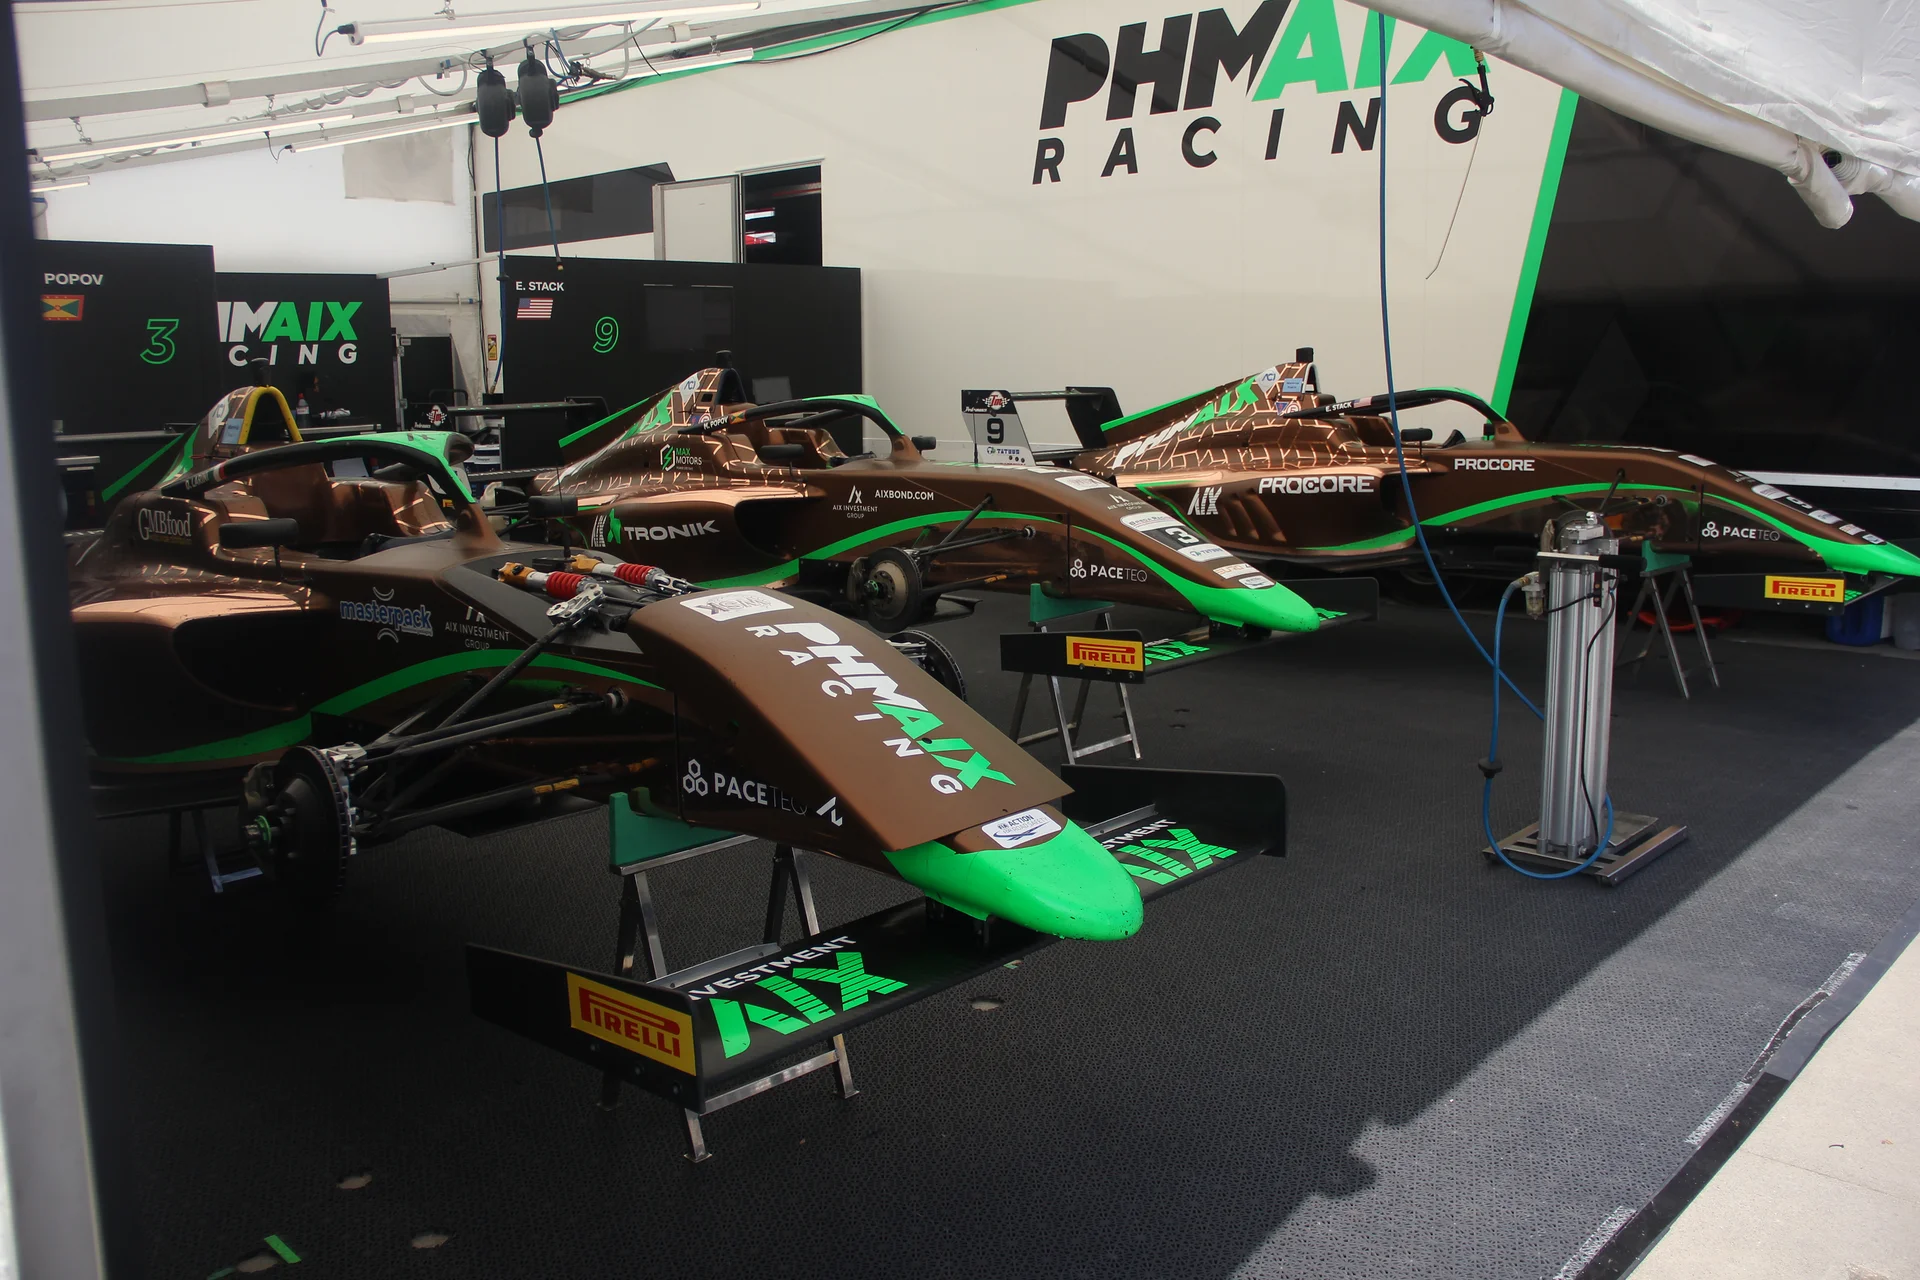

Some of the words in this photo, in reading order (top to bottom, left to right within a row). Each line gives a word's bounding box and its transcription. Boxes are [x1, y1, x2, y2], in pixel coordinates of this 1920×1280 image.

[1032, 86, 1483, 185] RACING
[44, 273, 104, 286] POPOV
[515, 281, 526, 291] E.
[528, 281, 565, 292] STACK
[140, 318, 180, 365] 3
[592, 316, 619, 354] 9
[1325, 405, 1332, 413] E.
[1332, 401, 1353, 411] STACK
[711, 415, 729, 429] POPOV
[986, 417, 1005, 445] 9
[675, 447, 691, 456] MAX
[675, 456, 703, 466] MOTORS
[1453, 458, 1536, 472] PROCORE
[1258, 475, 1375, 495] PROCORE
[874, 489, 935, 502] AIXBOND.COM
[843, 504, 878, 513] INVESTMENT
[138, 507, 192, 541] GMBfood
[624, 519, 721, 541] TRONIK
[1722, 525, 1781, 542] PACETEQ
[1164, 527, 1200, 545] 3
[1090, 564, 1148, 583] PACETEQ
[1772, 580, 1837, 598] PIRELLI
[339, 600, 433, 632] masterpack
[445, 620, 458, 633] AIX
[459, 623, 510, 642] INVESTMENT
[464, 638, 490, 651] GROUP
[1072, 642, 1136, 665] PIRELLI
[745, 624, 963, 794] RACING
[774, 622, 1016, 789] PHMAIX
[714, 772, 808, 817] PACETEQ
[1008, 814, 1035, 827] ACTION
[578, 986, 681, 1059] PIRELLI
